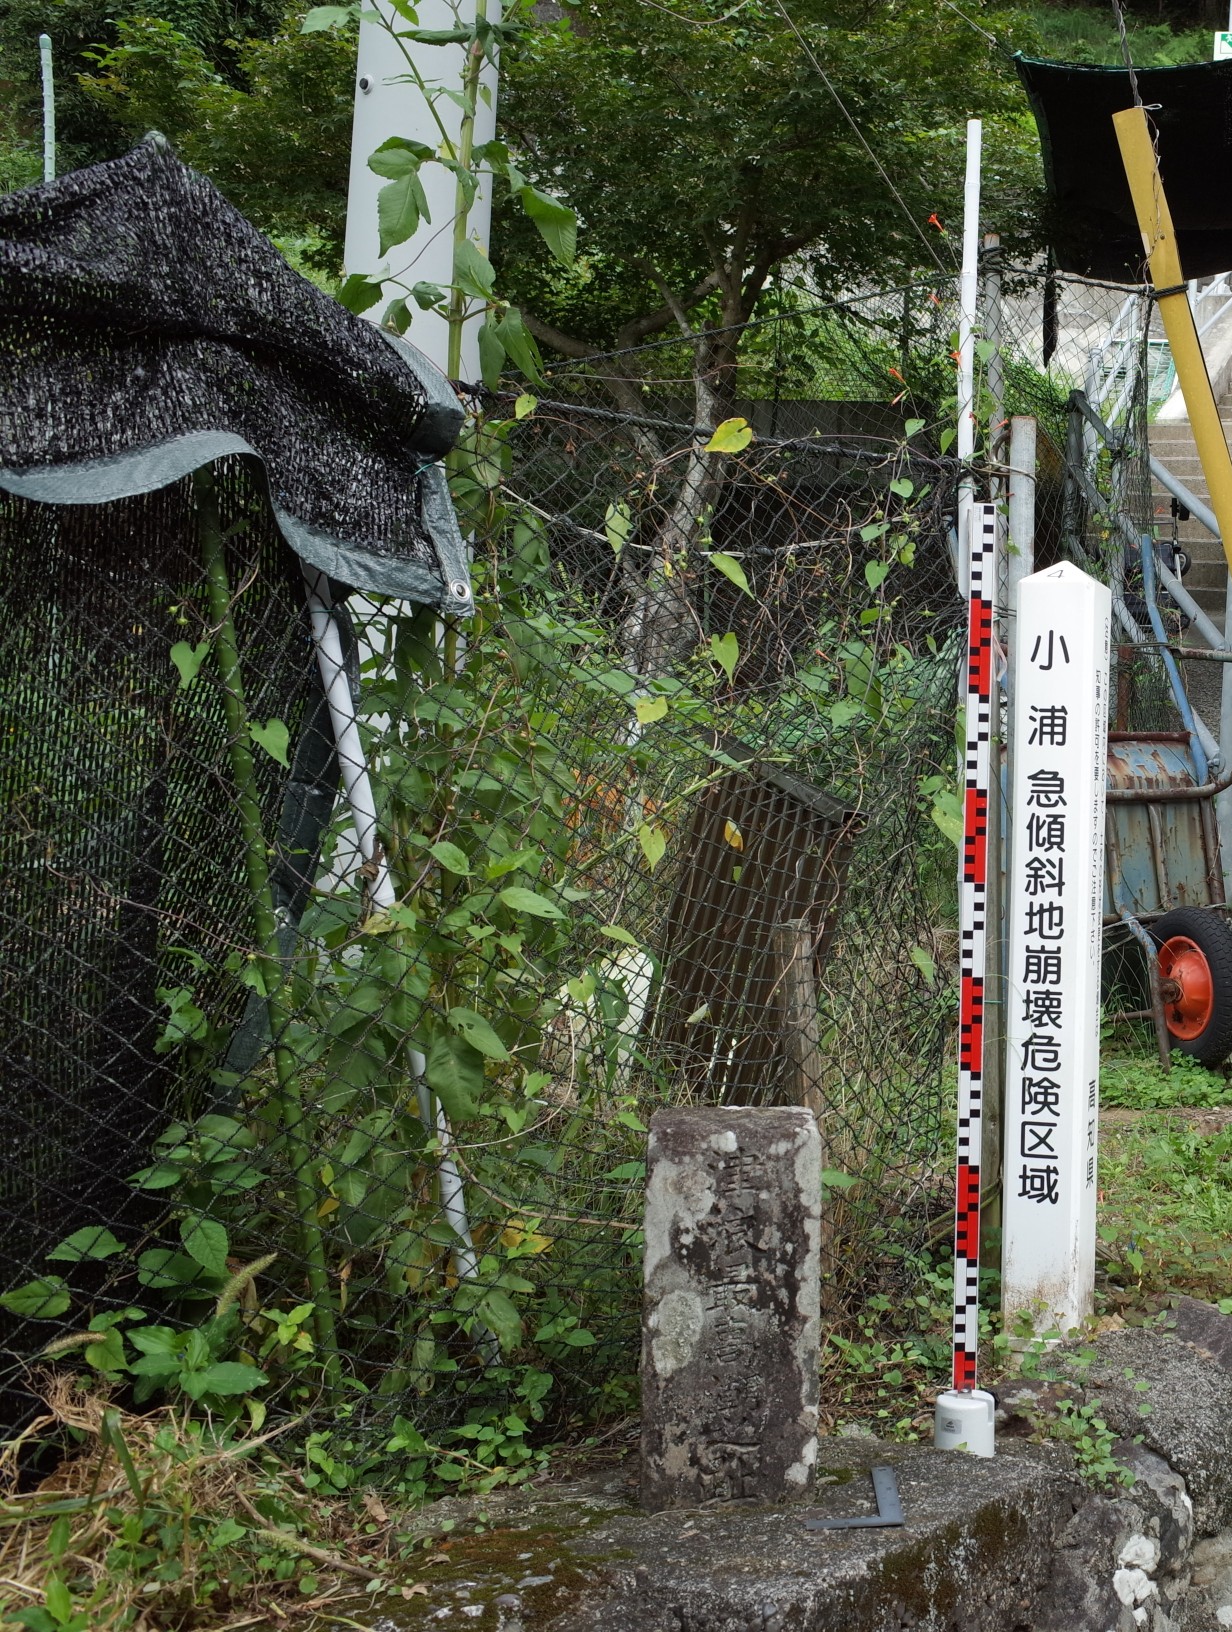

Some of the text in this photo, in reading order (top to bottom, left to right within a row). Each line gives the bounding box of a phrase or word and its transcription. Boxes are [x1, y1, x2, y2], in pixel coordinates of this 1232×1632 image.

[1047, 569, 1065, 579] 4
[1017, 629, 1070, 1205] 小浦急傾斜地崩壊危険区域
[1085, 1079, 1096, 1190] 高知県
